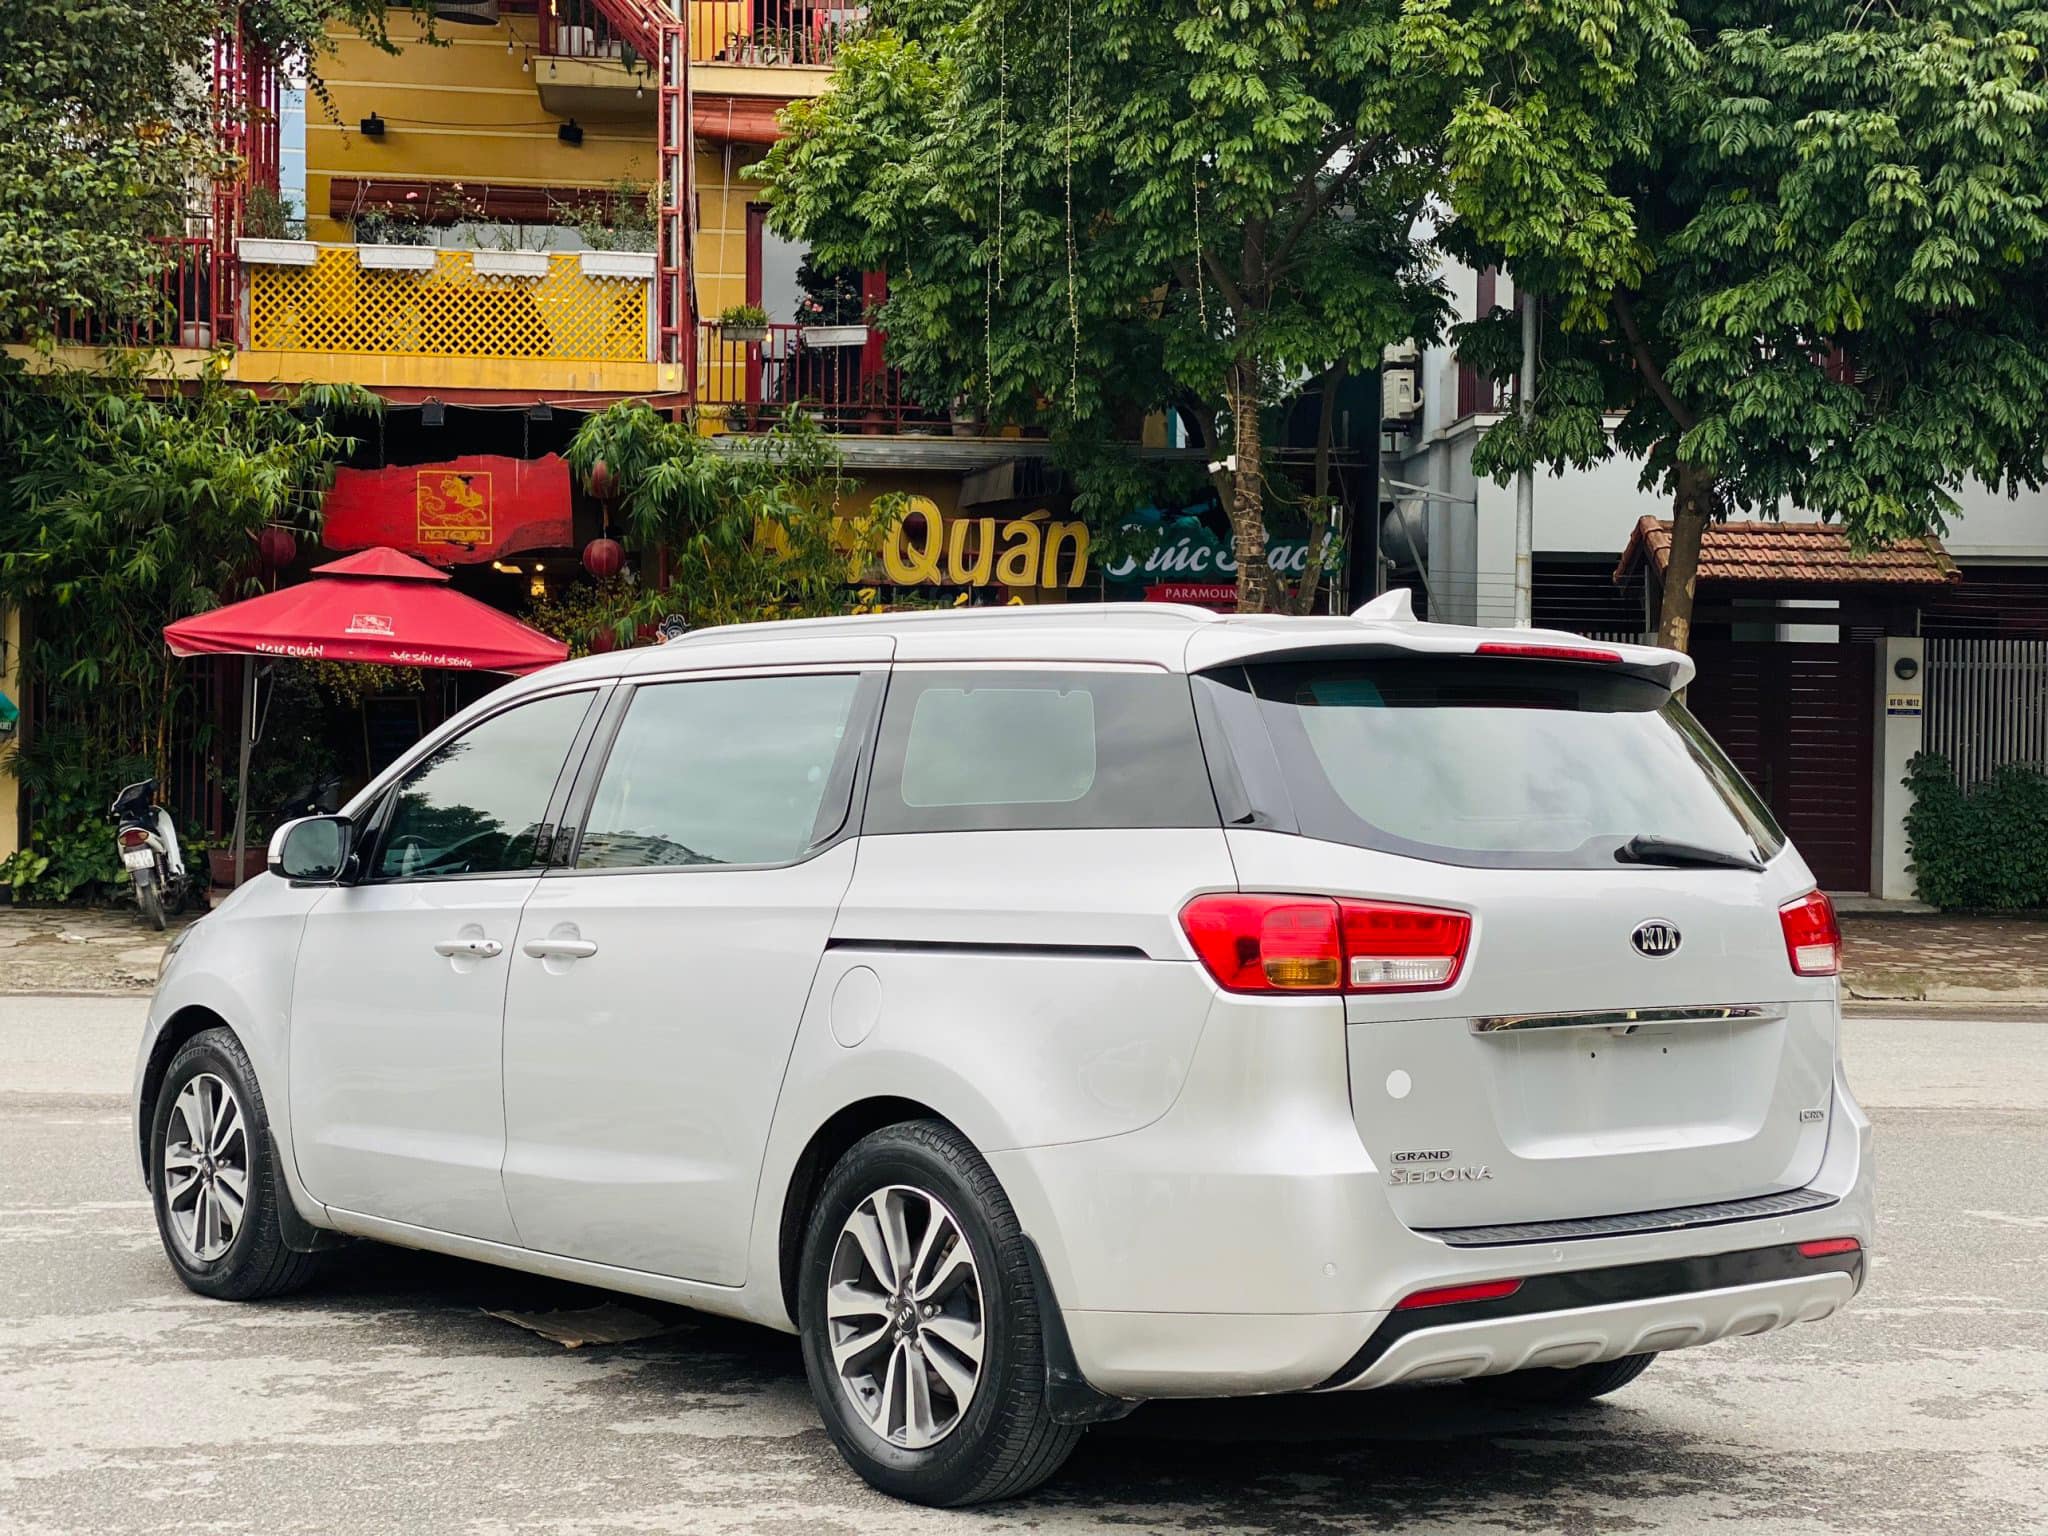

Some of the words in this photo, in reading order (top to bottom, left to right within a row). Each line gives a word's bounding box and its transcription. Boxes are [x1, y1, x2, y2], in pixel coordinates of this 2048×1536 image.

[883, 495, 1090, 588] Quán
[1165, 588, 1239, 600] PARAMOUN
[1640, 927, 1676, 950] KIA
[1395, 1150, 1450, 1161] GRAND
[1389, 1165, 1493, 1185] SEDONA
